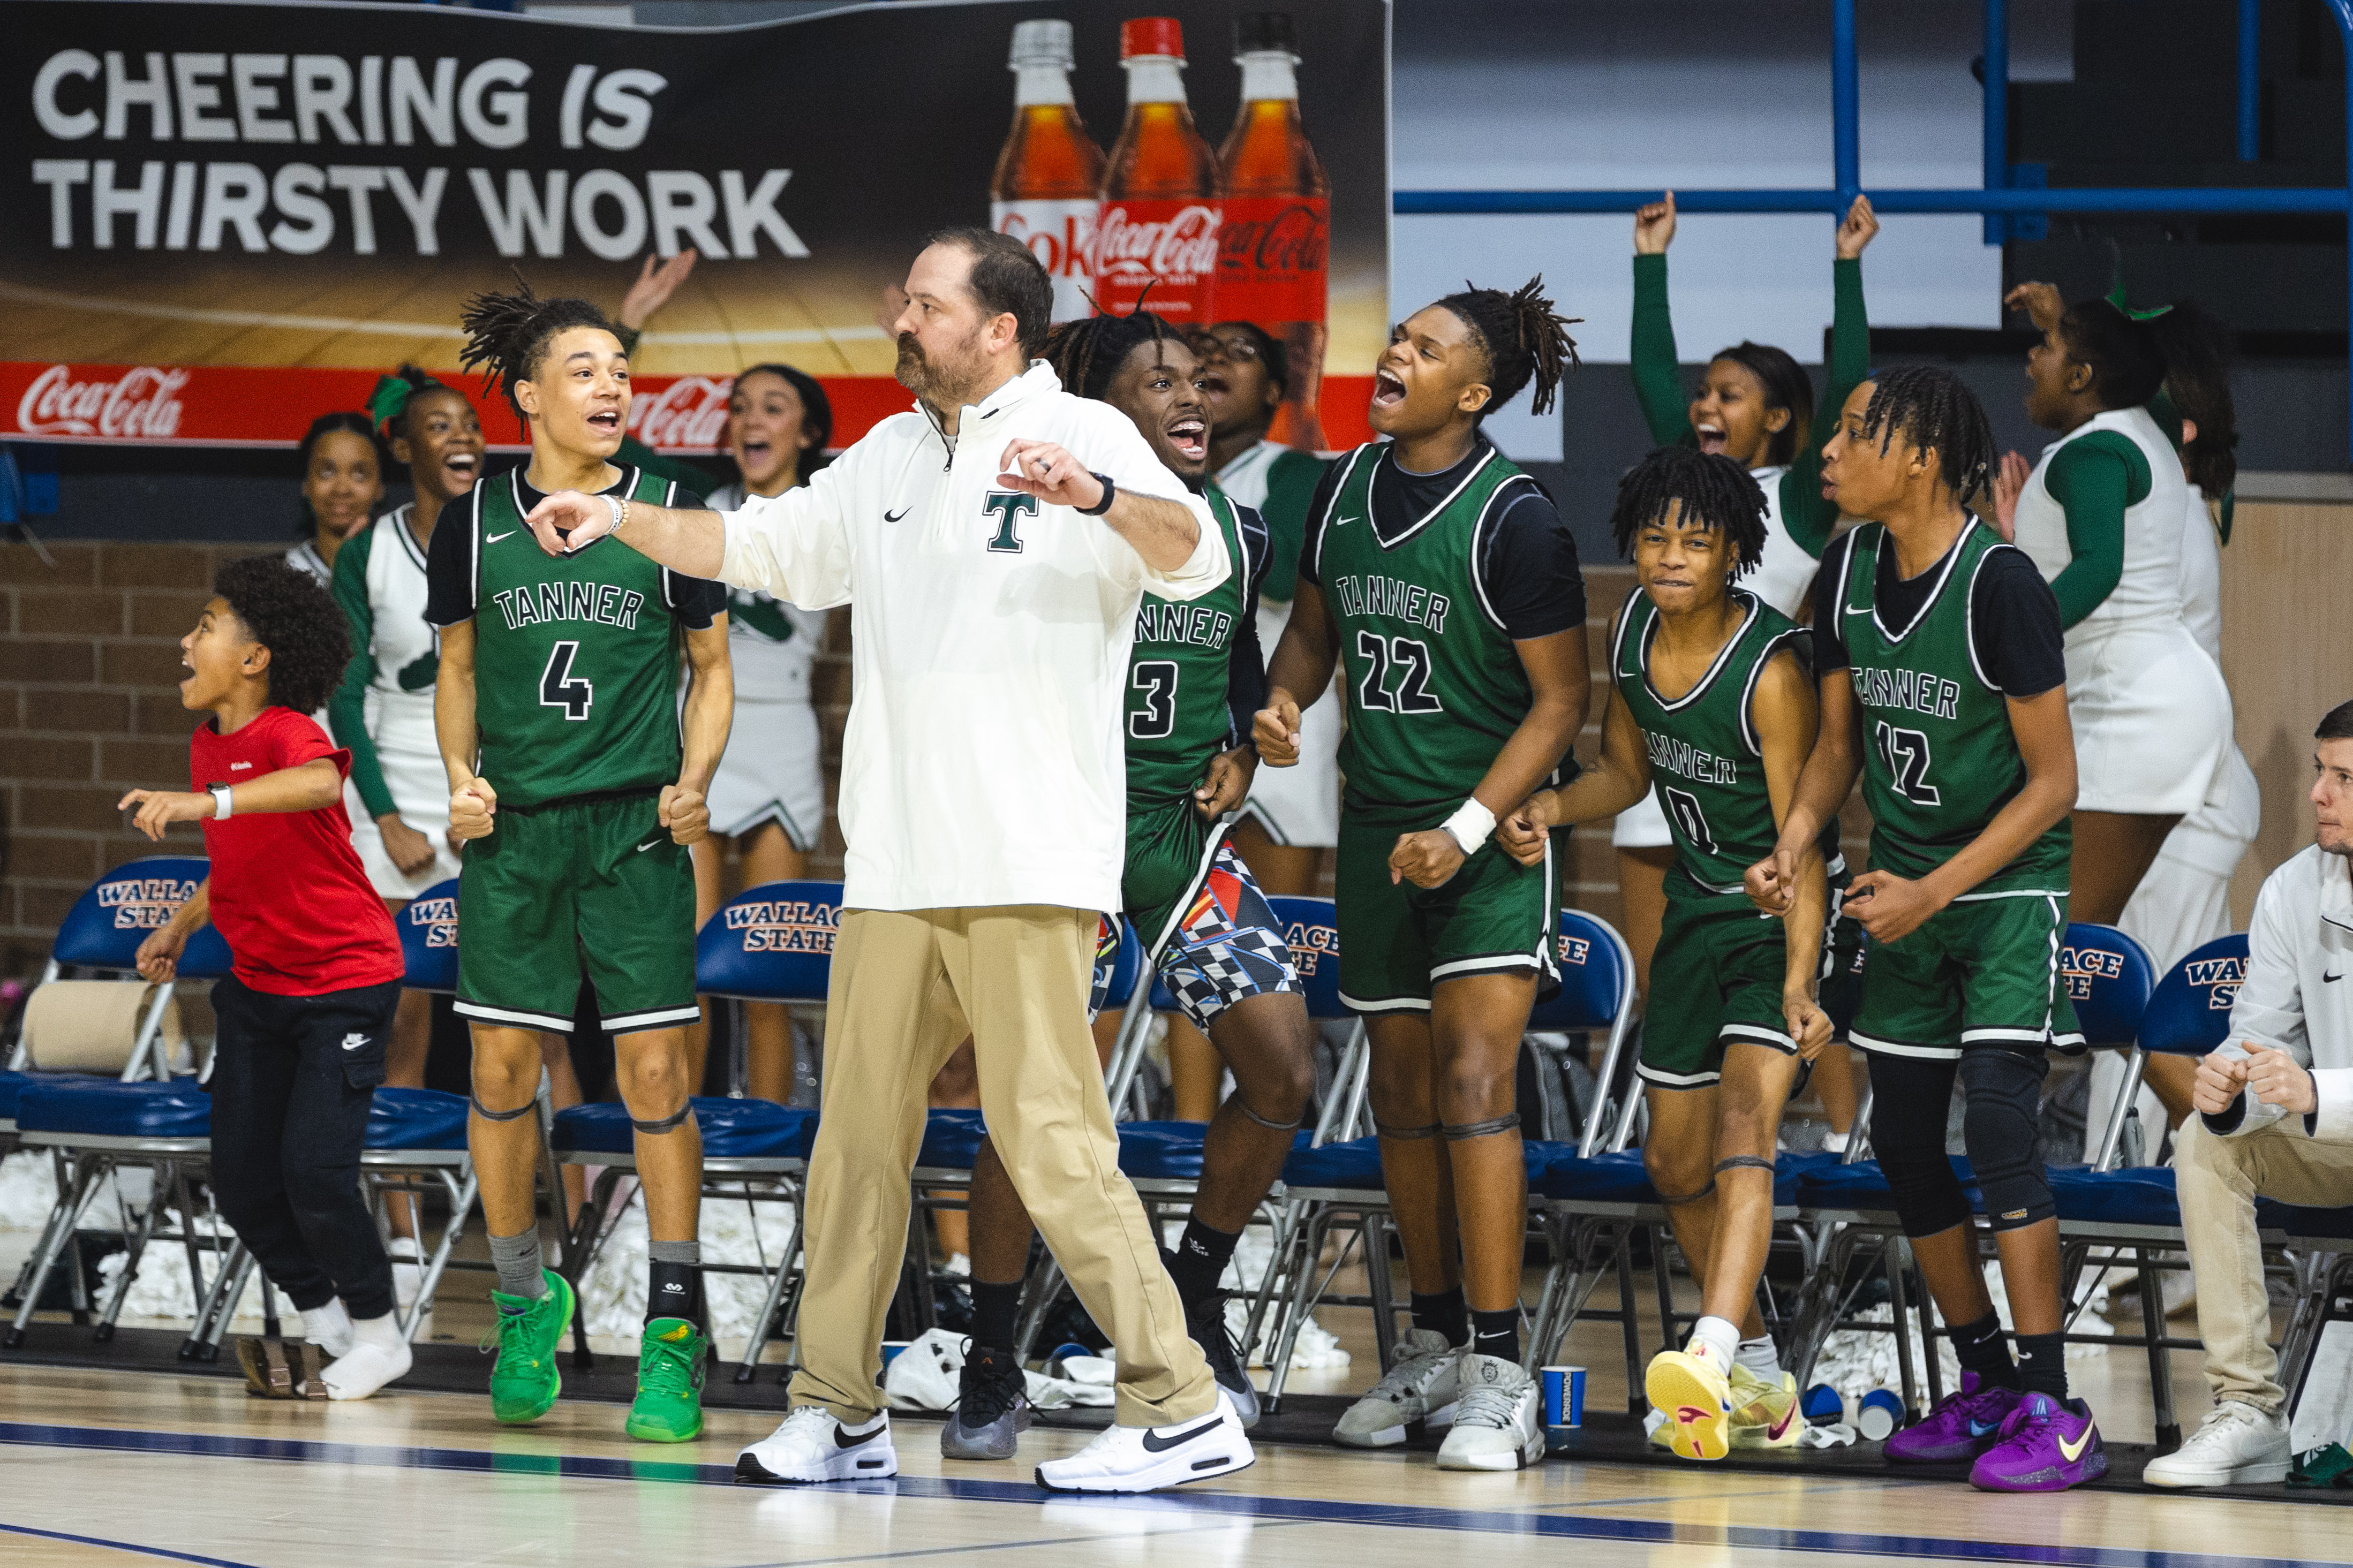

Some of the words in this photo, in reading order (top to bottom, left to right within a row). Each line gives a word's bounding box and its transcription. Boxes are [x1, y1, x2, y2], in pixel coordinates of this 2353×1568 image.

[32, 48, 533, 150] CHEERING
[559, 64, 669, 151] IS
[32, 158, 450, 256] THIRSTY
[466, 169, 811, 261] WORK
[17, 365, 191, 437] Coca-Cola
[982, 490, 1039, 554] T
[493, 581, 644, 630] TANNER
[1134, 604, 1232, 649] NNER
[1336, 575, 1450, 634] TANNER
[539, 641, 593, 721] 4
[1129, 660, 1179, 739] 3
[1357, 630, 1444, 714] 22
[1876, 719, 1941, 806] 12
[1665, 785, 1718, 855] 0
[97, 878, 197, 907] WALLA
[114, 905, 180, 929] STA
[725, 902, 844, 930] WALLAC
[1562, 1372, 1572, 1422] POWERADE
